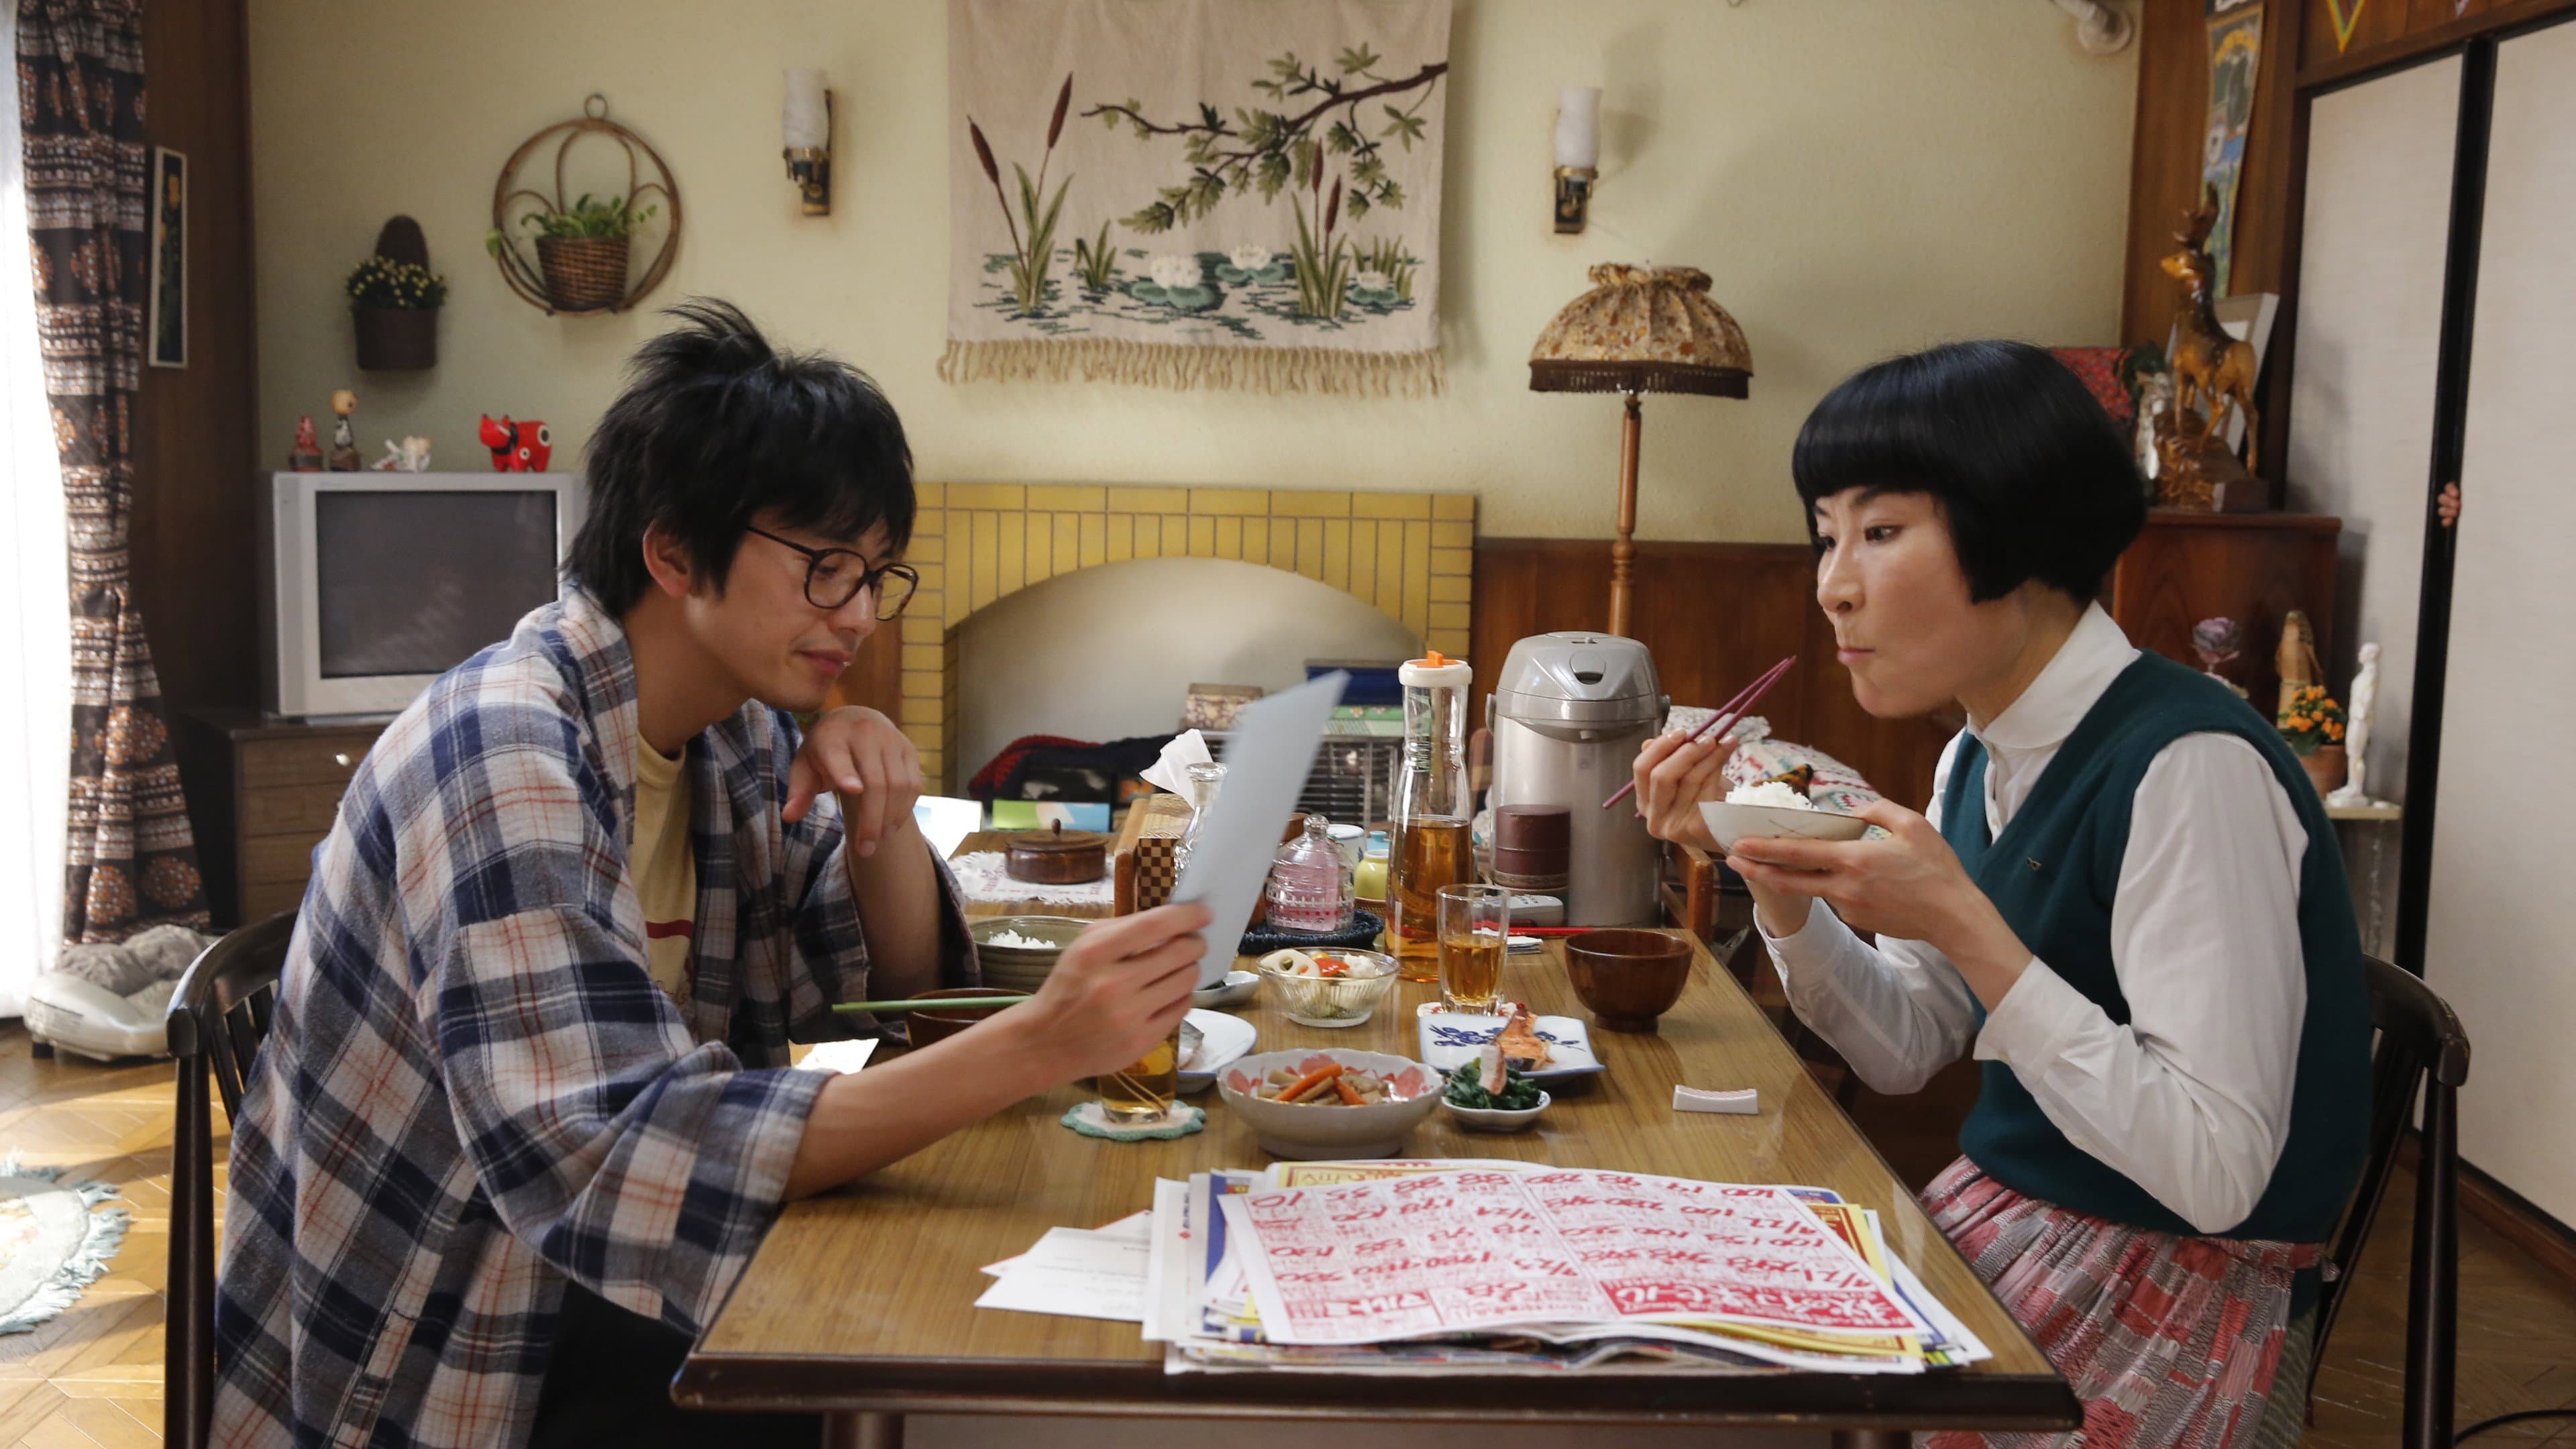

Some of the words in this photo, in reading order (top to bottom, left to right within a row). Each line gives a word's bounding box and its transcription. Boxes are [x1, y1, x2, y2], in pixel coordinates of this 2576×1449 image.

[1721, 1188, 1775, 1199] 100
[1251, 1191, 1304, 1208] 10
[1680, 1206, 1734, 1217] 100
